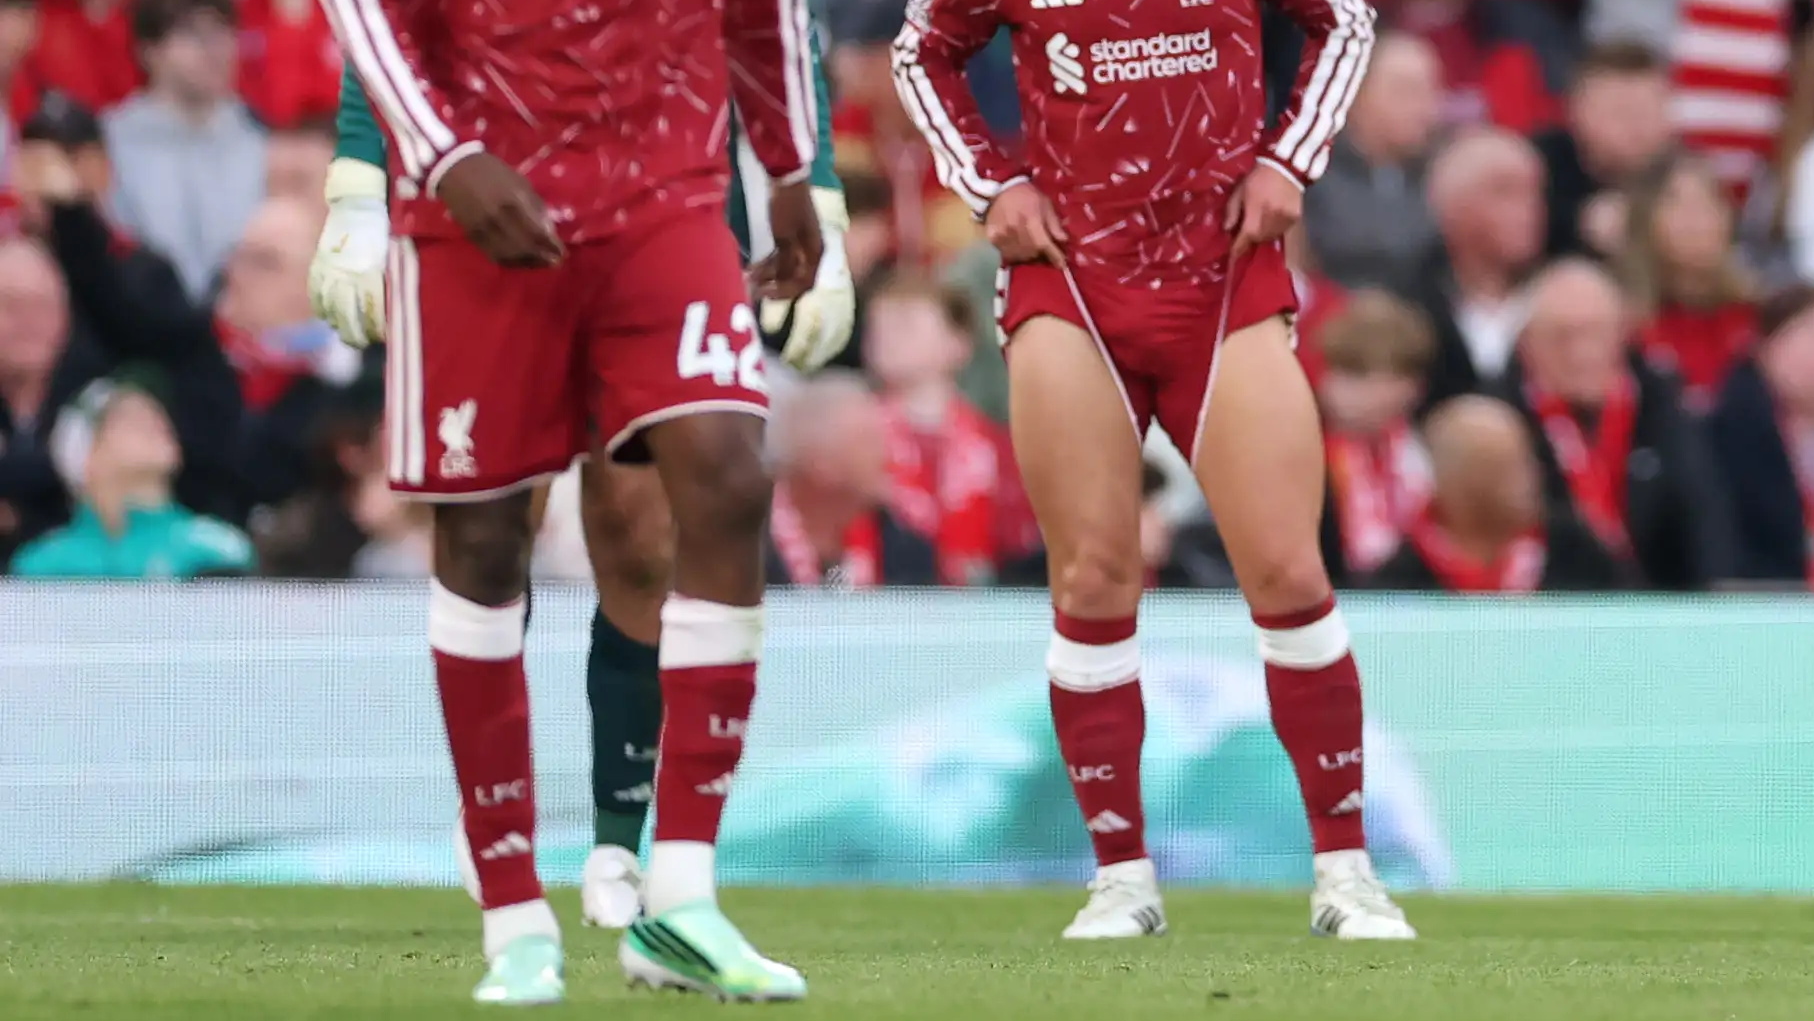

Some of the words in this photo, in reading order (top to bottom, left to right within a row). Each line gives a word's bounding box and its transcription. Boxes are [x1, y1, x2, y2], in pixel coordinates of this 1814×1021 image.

[1089, 26, 1211, 62] standard
[1092, 47, 1218, 84] chartered
[1068, 765, 1116, 782] LFC
